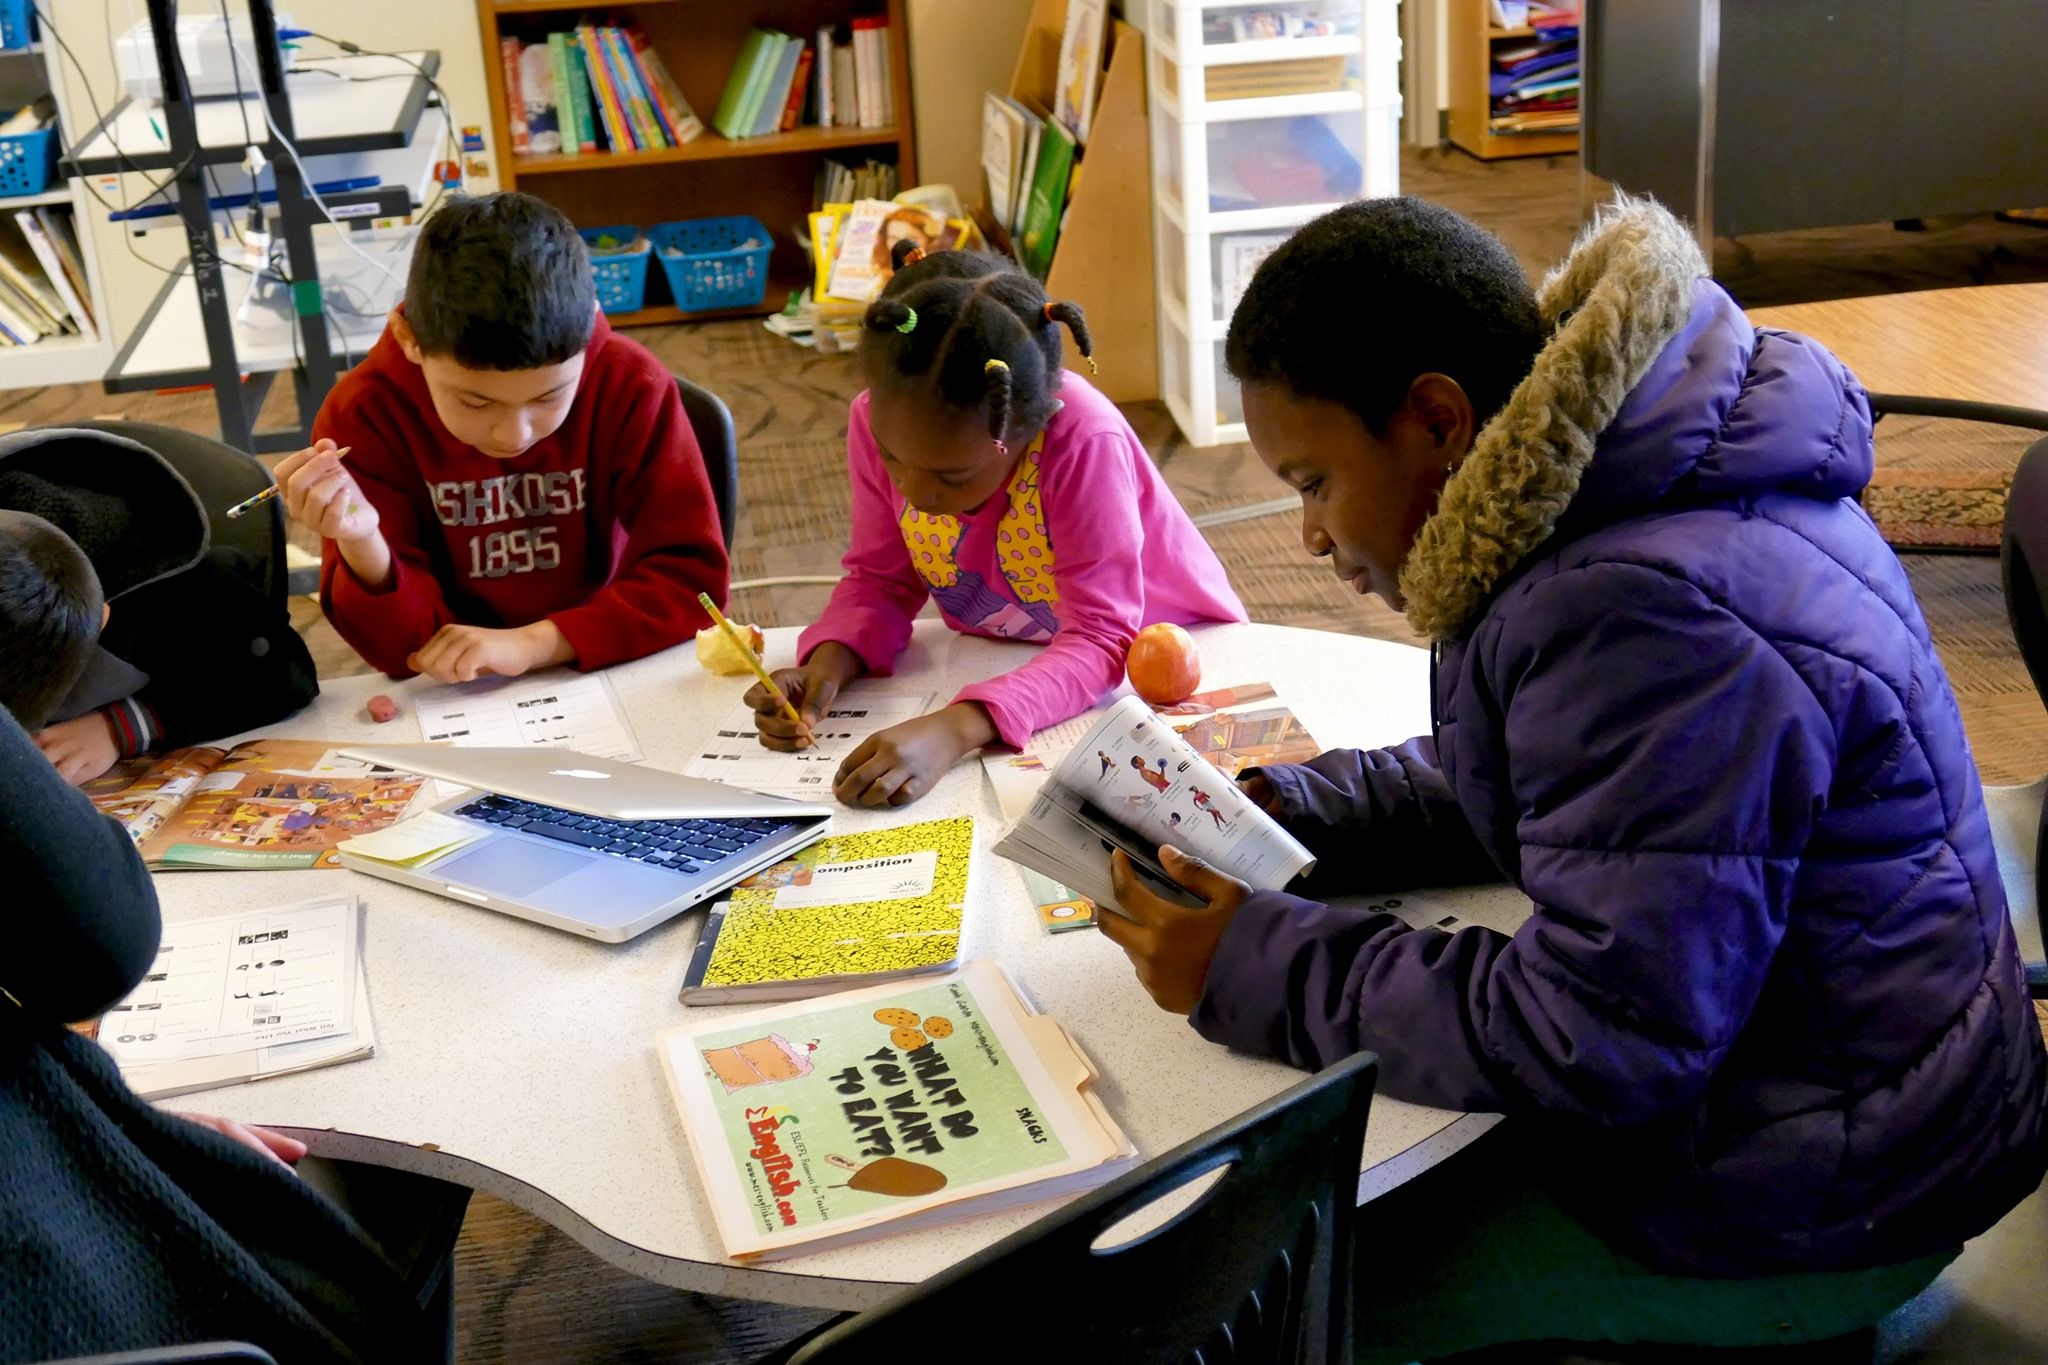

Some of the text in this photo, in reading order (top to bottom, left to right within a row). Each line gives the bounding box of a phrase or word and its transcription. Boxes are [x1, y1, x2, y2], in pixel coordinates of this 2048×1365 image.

[468, 526, 561, 578] 1895
[813, 856, 914, 874] omposition
[828, 1066, 866, 1095] TO
[864, 1046, 945, 1155] YOU WANT
[905, 1041, 979, 1139] WHAT DO
[840, 1097, 896, 1158] EAT?
[1016, 1107, 1048, 1144] SNACKS
[745, 1162, 775, 1233] www.mes-english.com
[790, 1131, 830, 1221] ESL/EFL Resources for Teachers
